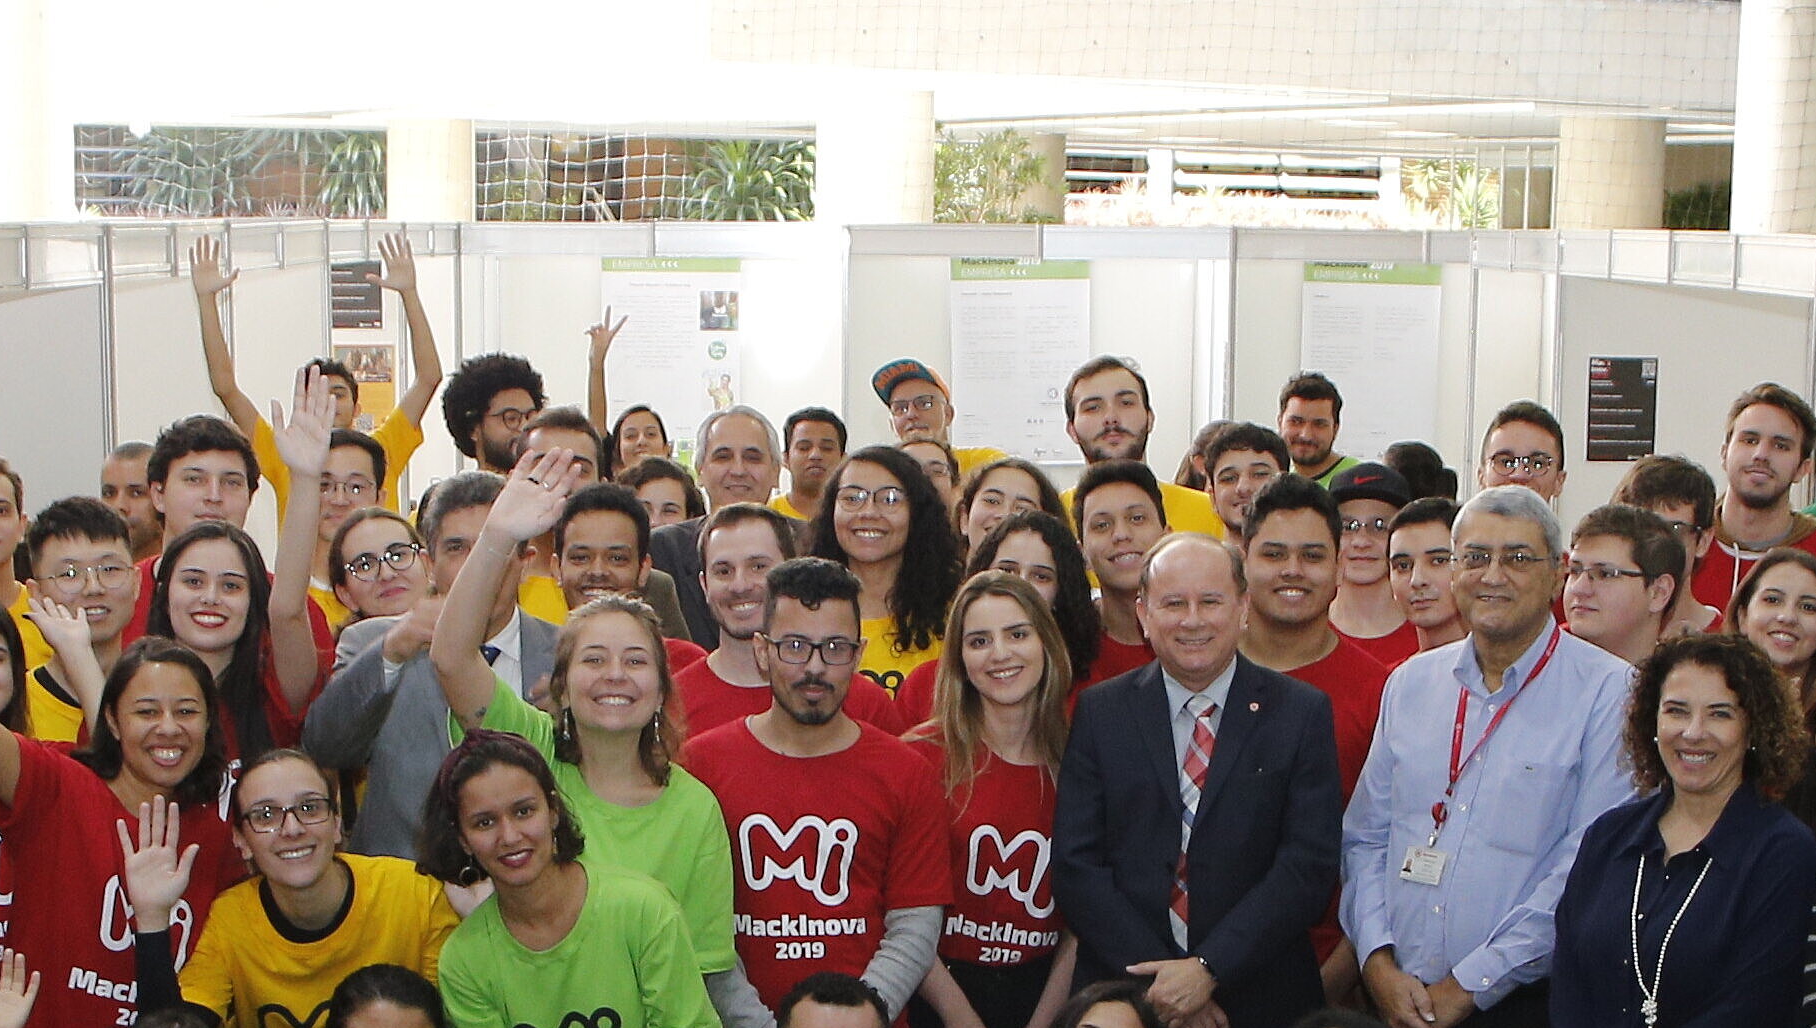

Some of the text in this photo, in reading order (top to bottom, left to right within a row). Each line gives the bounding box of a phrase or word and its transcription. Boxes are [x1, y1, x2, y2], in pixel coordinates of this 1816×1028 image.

[734, 913, 867, 937] MackInova
[775, 941, 825, 960] 2019
[979, 946, 1022, 963] 2019
